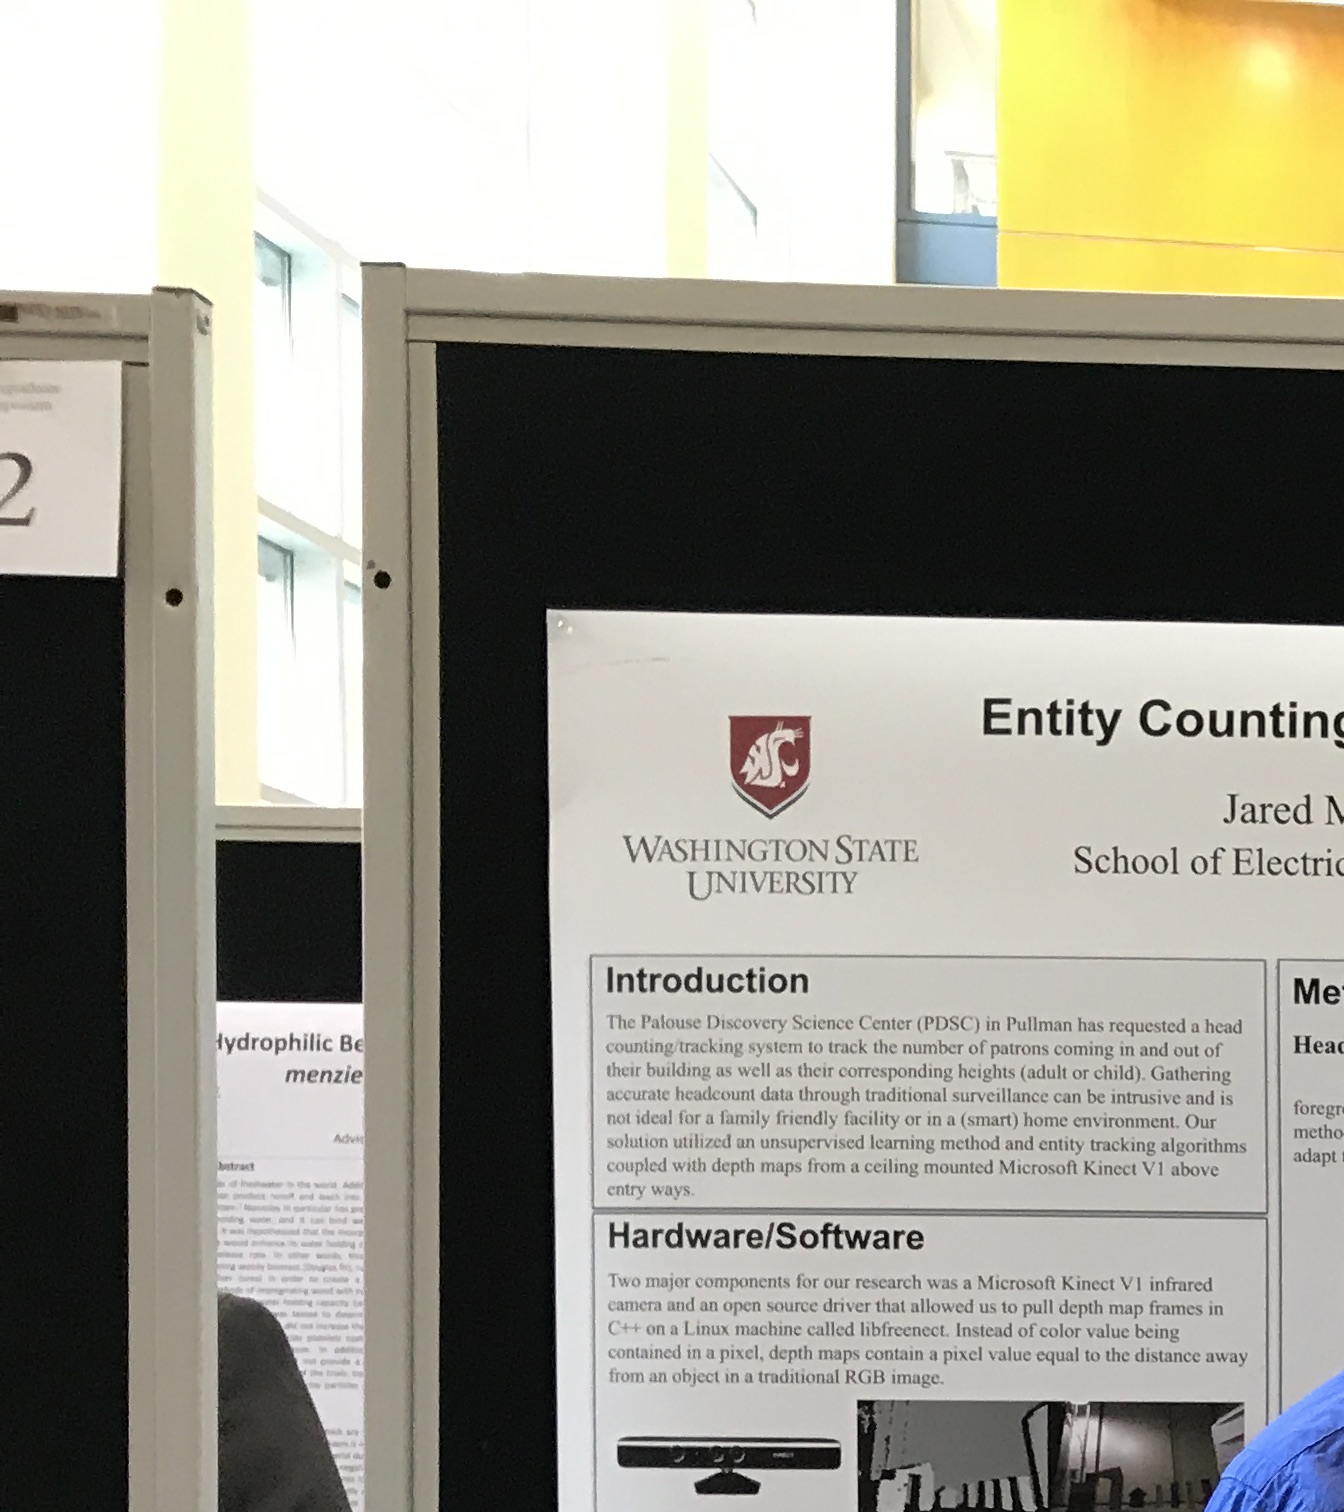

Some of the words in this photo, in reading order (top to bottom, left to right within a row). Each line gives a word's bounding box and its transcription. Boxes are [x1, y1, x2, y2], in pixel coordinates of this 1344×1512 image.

[982, 698, 1121, 744] Entity
[1222, 792, 1313, 826] Jared
[622, 834, 828, 865] WASHINGTON
[835, 836, 919, 865] STATE
[1073, 845, 1179, 876] School
[1190, 846, 1227, 875] of
[688, 870, 858, 902] UNIVERSITY
[606, 966, 809, 994] Introduction
[606, 1014, 636, 1031] The
[641, 1014, 701, 1030] Palouse
[706, 1015, 787, 1034] Discovery
[792, 1015, 853, 1031] Science
[859, 1017, 911, 1031] Center
[917, 1016, 980, 1034] (PDSC)
[986, 1018, 1002, 1031] in
[1007, 1017, 1071, 1032] Pullman
[1077, 1018, 1104, 1032] has
[1109, 1018, 1186, 1036] requested
[1191, 1023, 1199, 1033] a
[1205, 1019, 1243, 1034] head
[285, 1064, 363, 1085] menzie
[606, 1221, 925, 1252] Hardware/Software
